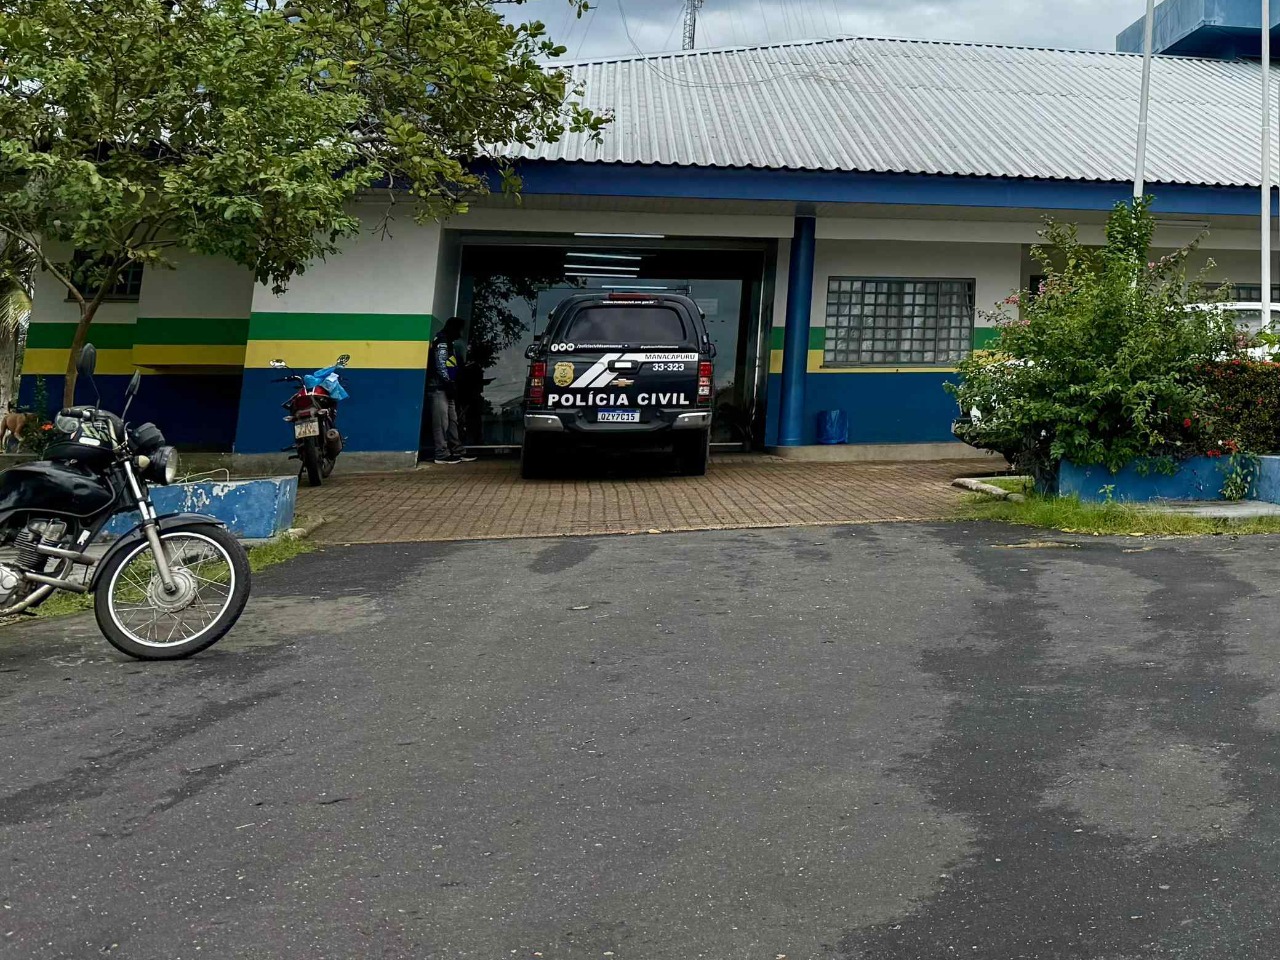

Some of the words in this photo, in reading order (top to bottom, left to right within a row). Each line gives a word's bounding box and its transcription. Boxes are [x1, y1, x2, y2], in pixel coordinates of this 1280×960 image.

[652, 363, 685, 371] 33-323
[547, 391, 629, 406] POLÍCIA
[637, 393, 690, 405] CIVIL
